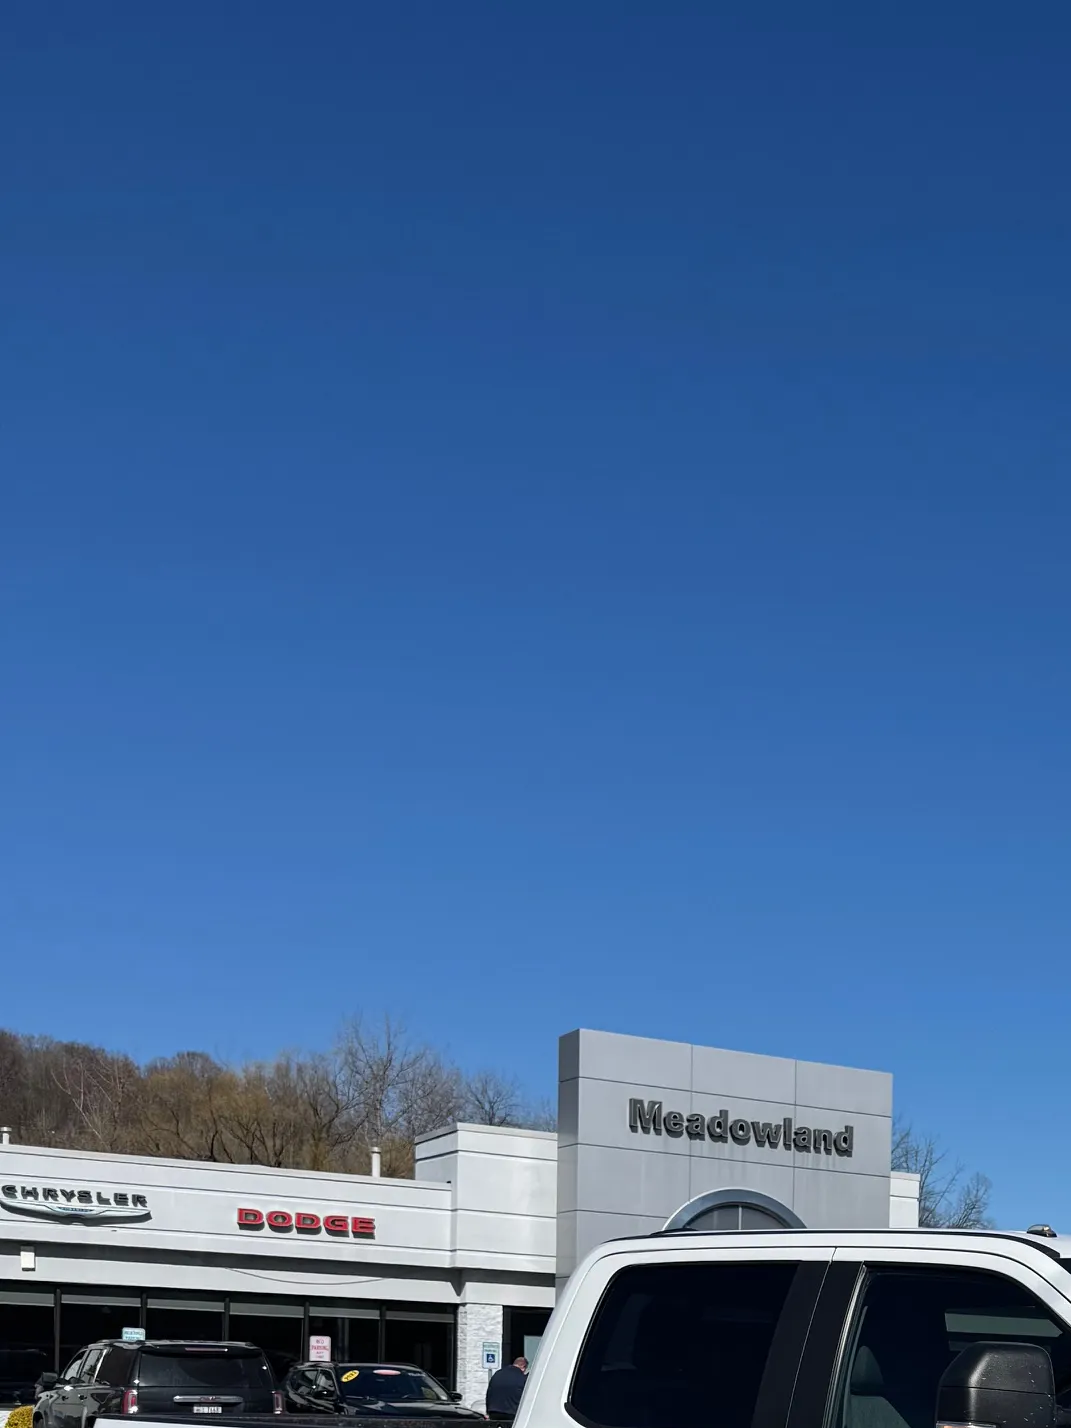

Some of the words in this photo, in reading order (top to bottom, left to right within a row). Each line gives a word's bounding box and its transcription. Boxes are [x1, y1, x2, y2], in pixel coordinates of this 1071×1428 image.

[628, 1097, 854, 1157] Meadowland
[1, 1184, 148, 1208] CHRYSLER
[237, 1207, 376, 1240] DODGE
